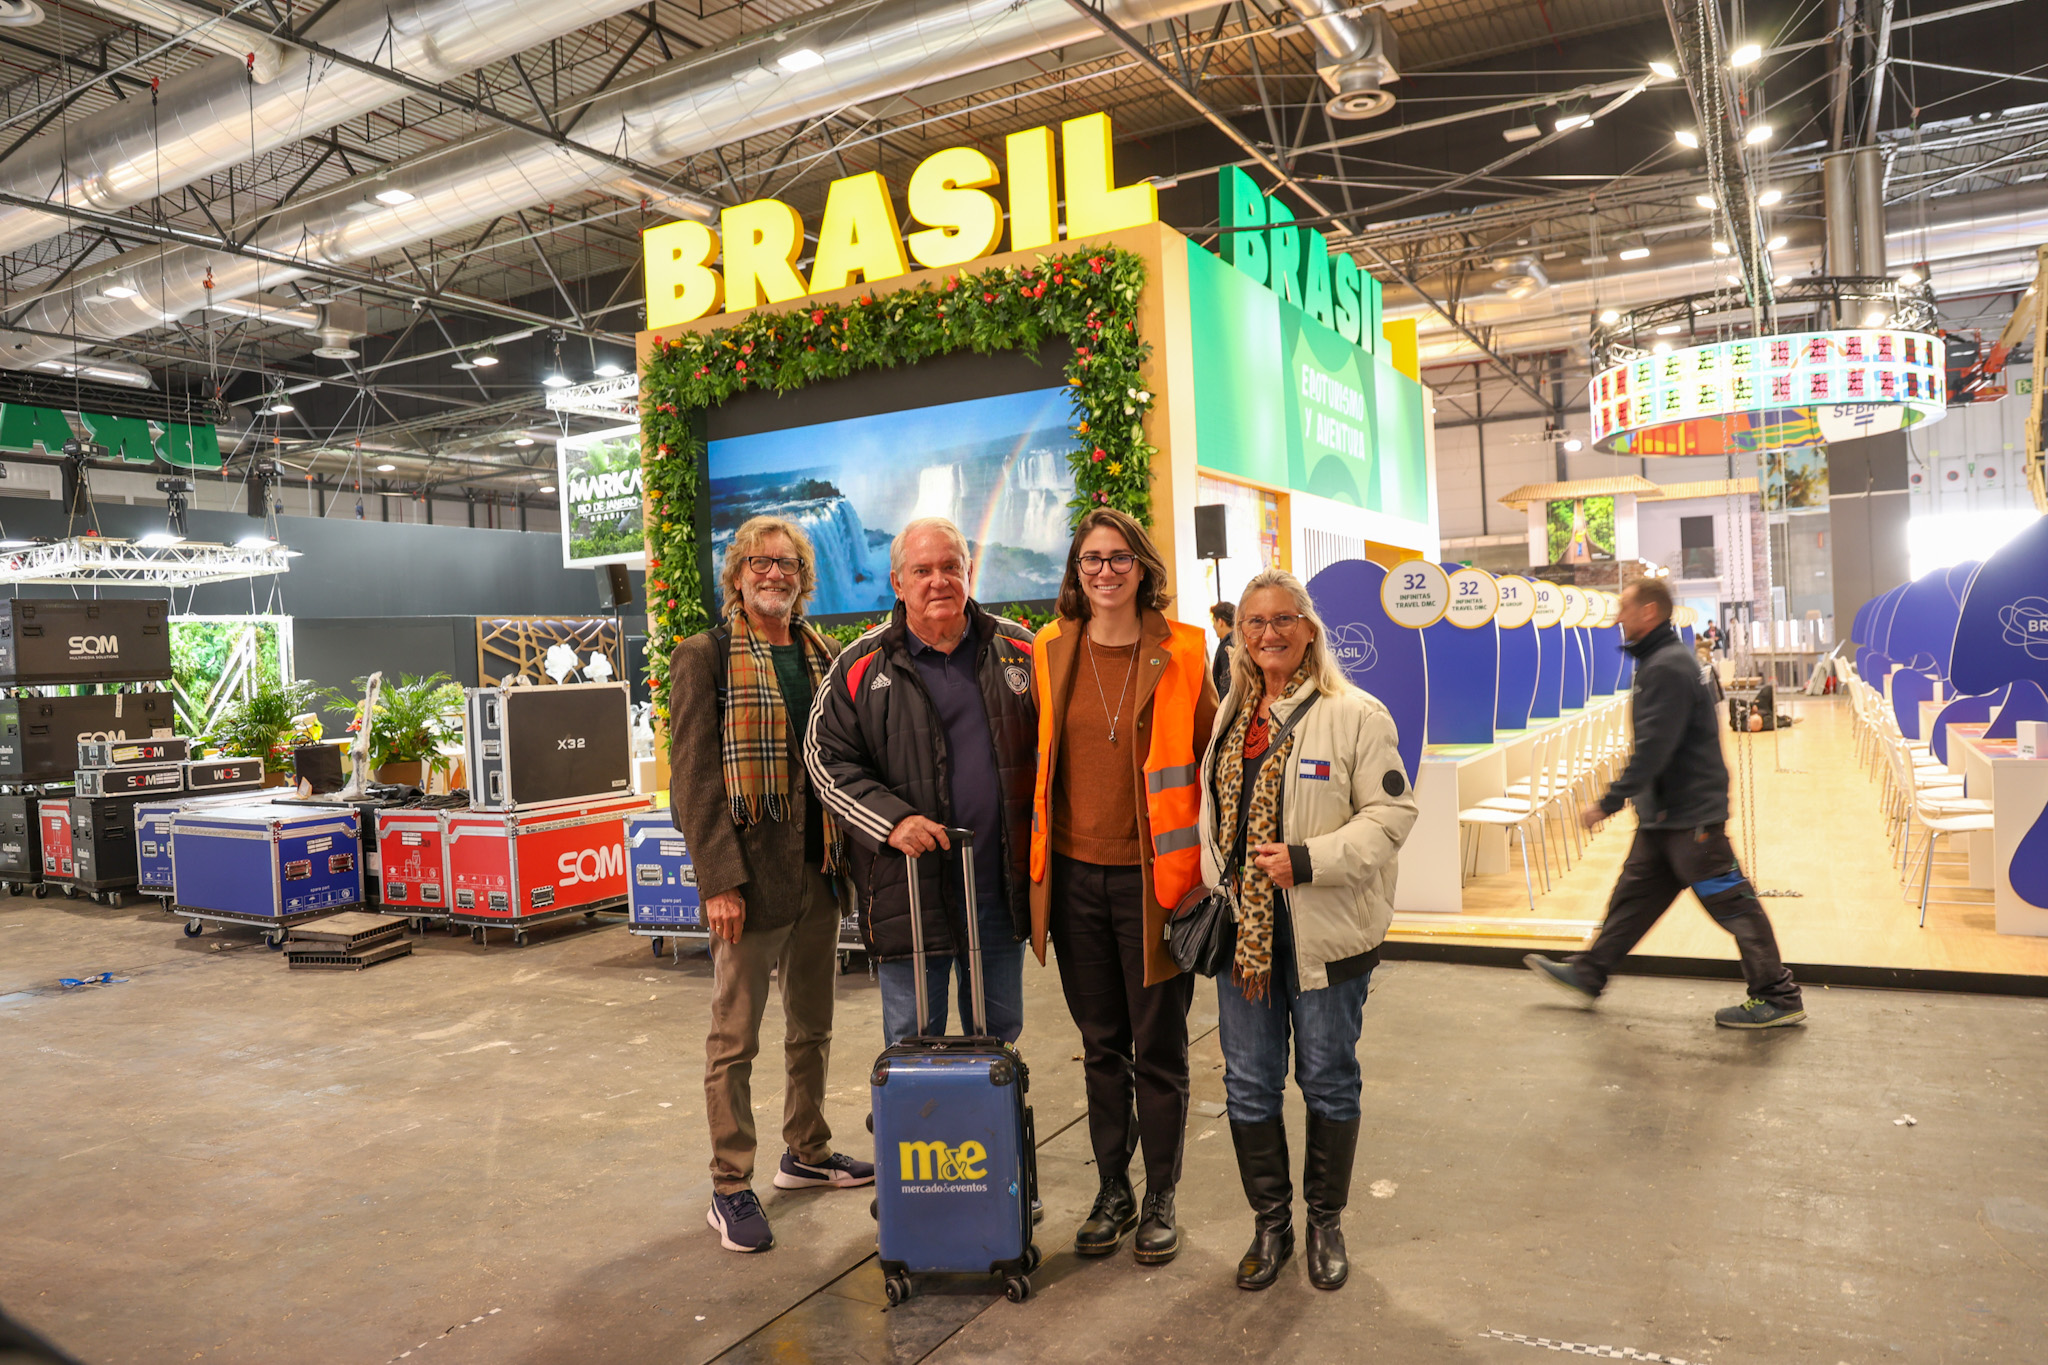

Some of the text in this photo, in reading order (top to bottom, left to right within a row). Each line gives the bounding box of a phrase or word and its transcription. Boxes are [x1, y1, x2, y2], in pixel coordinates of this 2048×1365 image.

[643, 111, 1158, 330] BRASIL
[1220, 164, 1392, 367] BRASIL
[1301, 363, 1364, 422] ECOTURISMO
[1304, 407, 1365, 461] Y AVENTURA
[578, 496, 638, 514] RIO DE JANEIRO
[590, 512, 625, 522] BRASIL
[1403, 573, 1426, 590] 32
[1459, 581, 1479, 595] 32
[1501, 587, 1517, 599] 31
[1566, 595, 1573, 604] 9
[69, 635, 118, 654] SQM
[557, 738, 586, 750] X32
[127, 776, 156, 788] SQM
[558, 843, 624, 887] SQM
[898, 1140, 988, 1181] m&e
[901, 1183, 988, 1193] mercado&eventos
